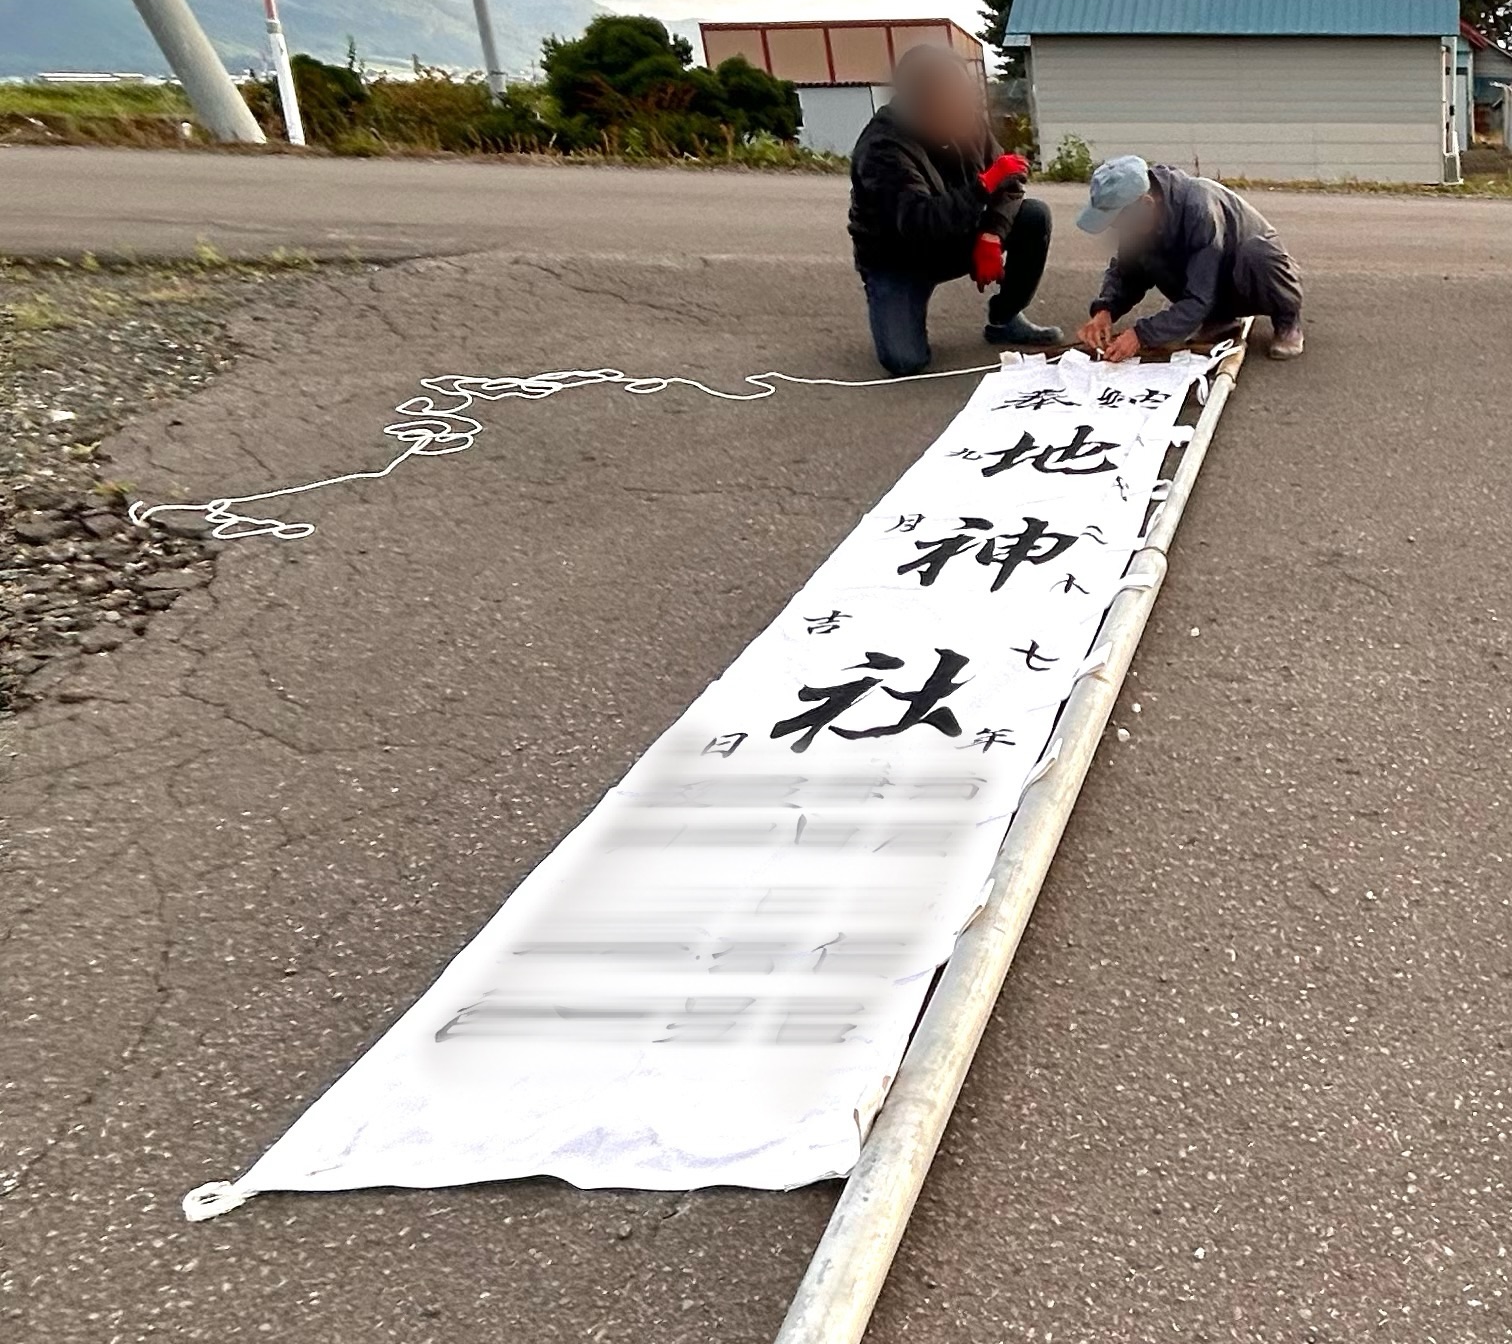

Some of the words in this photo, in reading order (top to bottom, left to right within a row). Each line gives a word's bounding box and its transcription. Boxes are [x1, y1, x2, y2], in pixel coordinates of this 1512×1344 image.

[991, 387, 1172, 411] 奉納
[701, 446, 984, 759] 九月吉日
[770, 423, 1118, 753] 地神社
